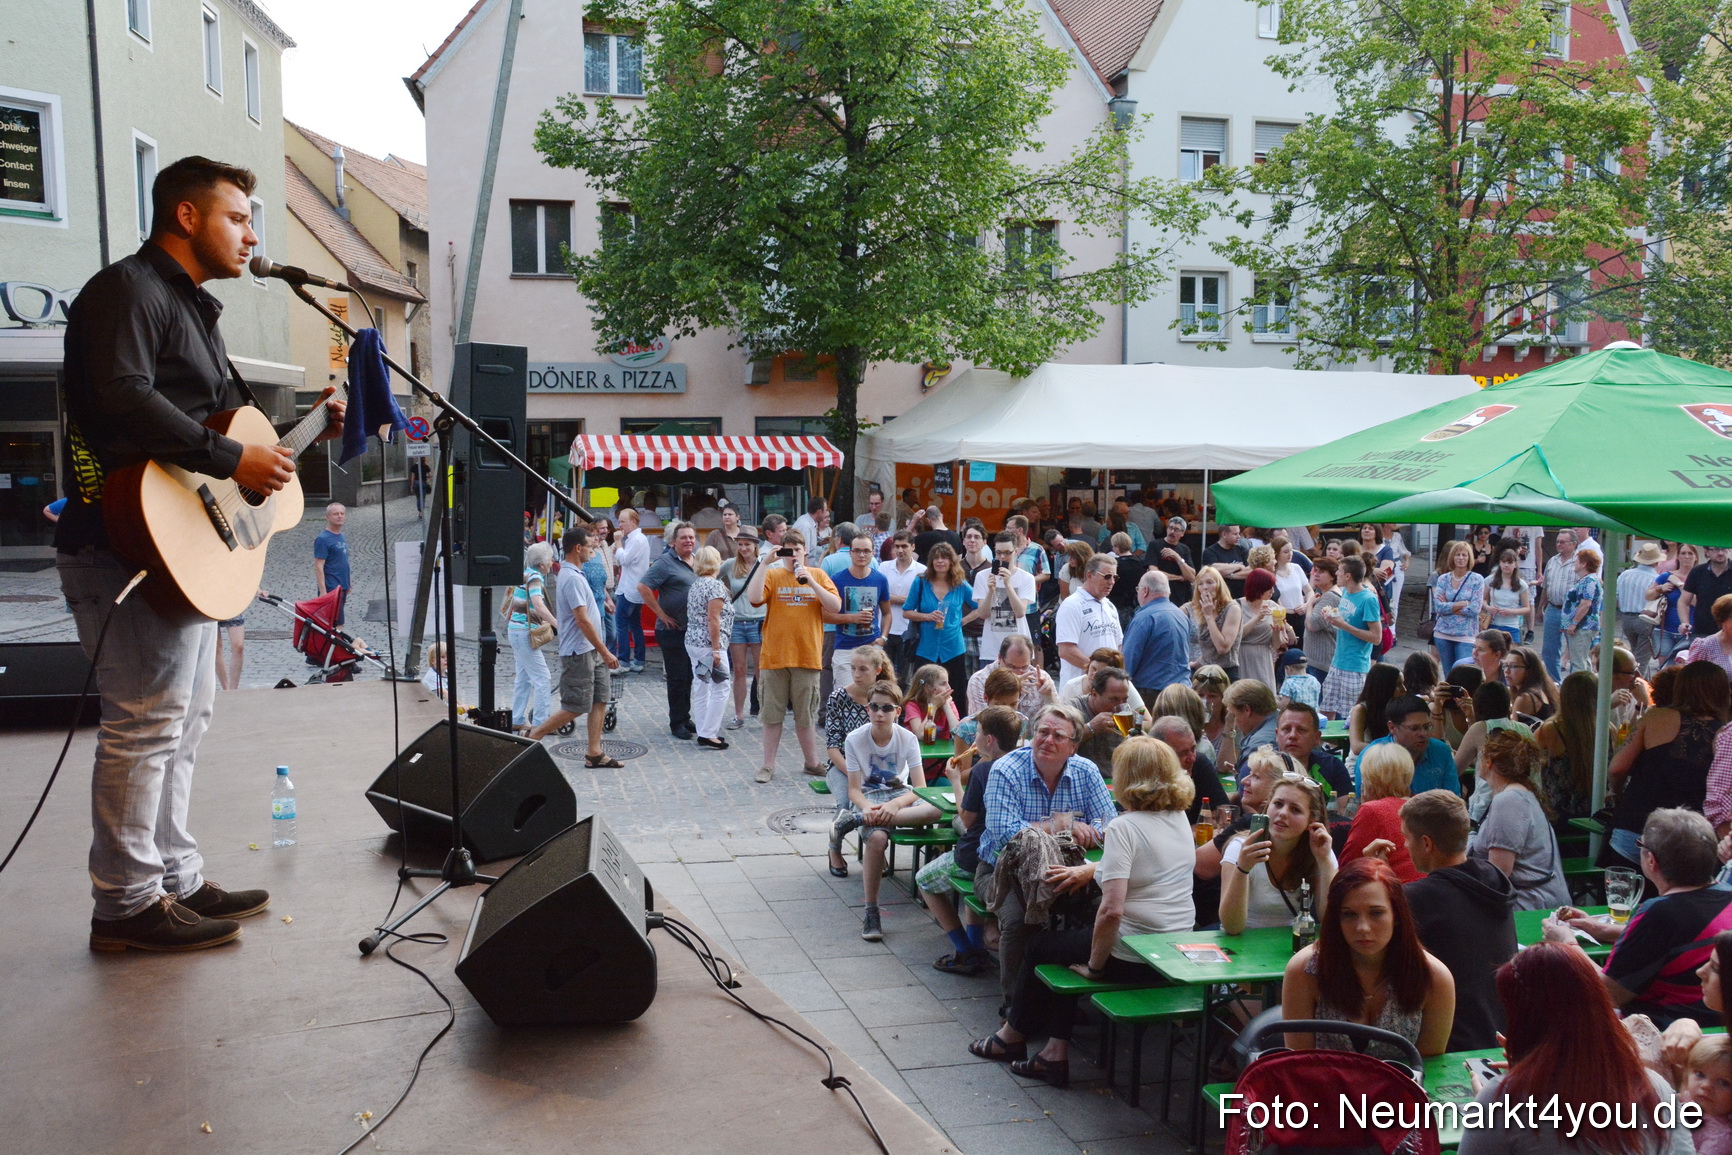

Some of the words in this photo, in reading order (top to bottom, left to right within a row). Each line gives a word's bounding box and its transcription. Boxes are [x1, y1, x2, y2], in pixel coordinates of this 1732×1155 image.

[0, 158, 34, 171] Contact
[3, 178, 30, 189] linsen
[528, 366, 599, 389] DÖNER
[603, 373, 616, 389] &
[622, 370, 677, 389] PIZZA
